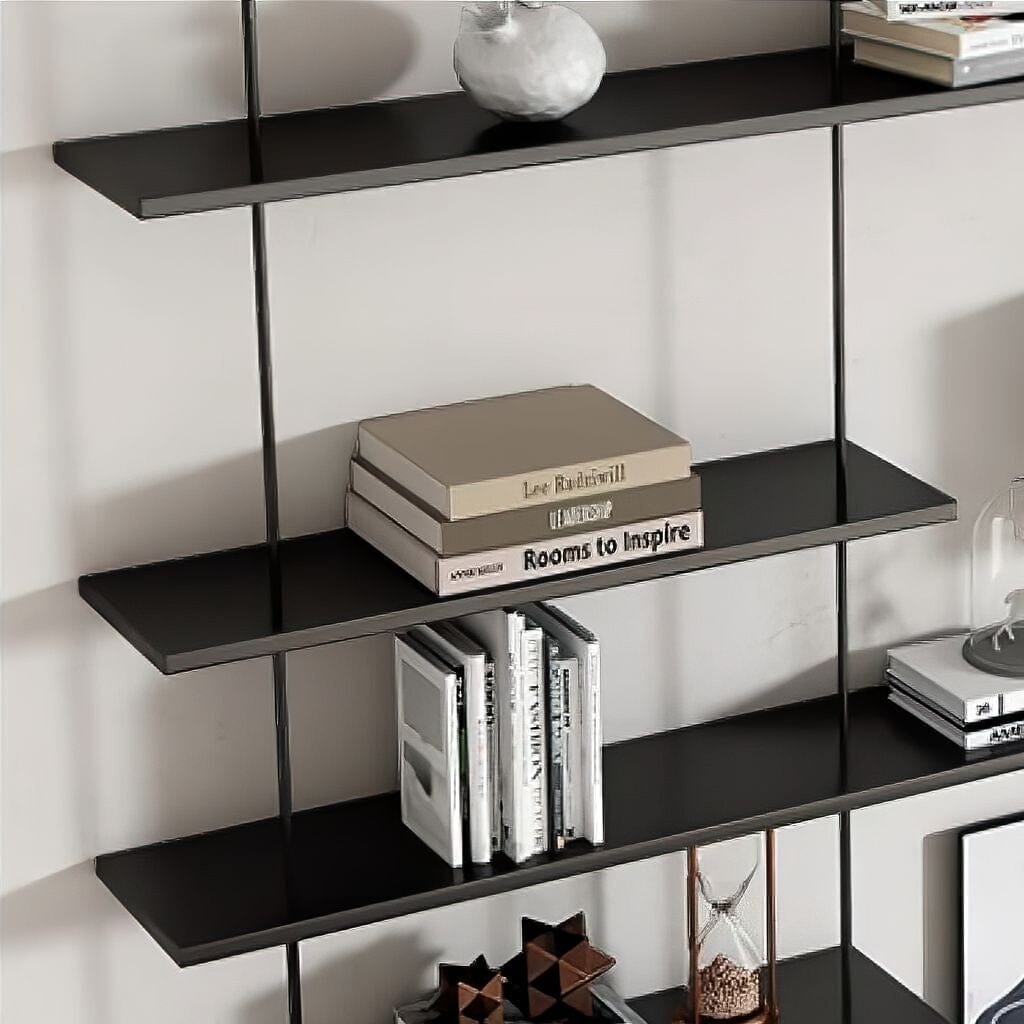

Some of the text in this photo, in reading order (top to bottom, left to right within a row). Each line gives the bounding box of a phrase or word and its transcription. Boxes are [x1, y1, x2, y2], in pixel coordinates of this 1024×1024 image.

[523, 521, 691, 571] Rooms to Inspire
